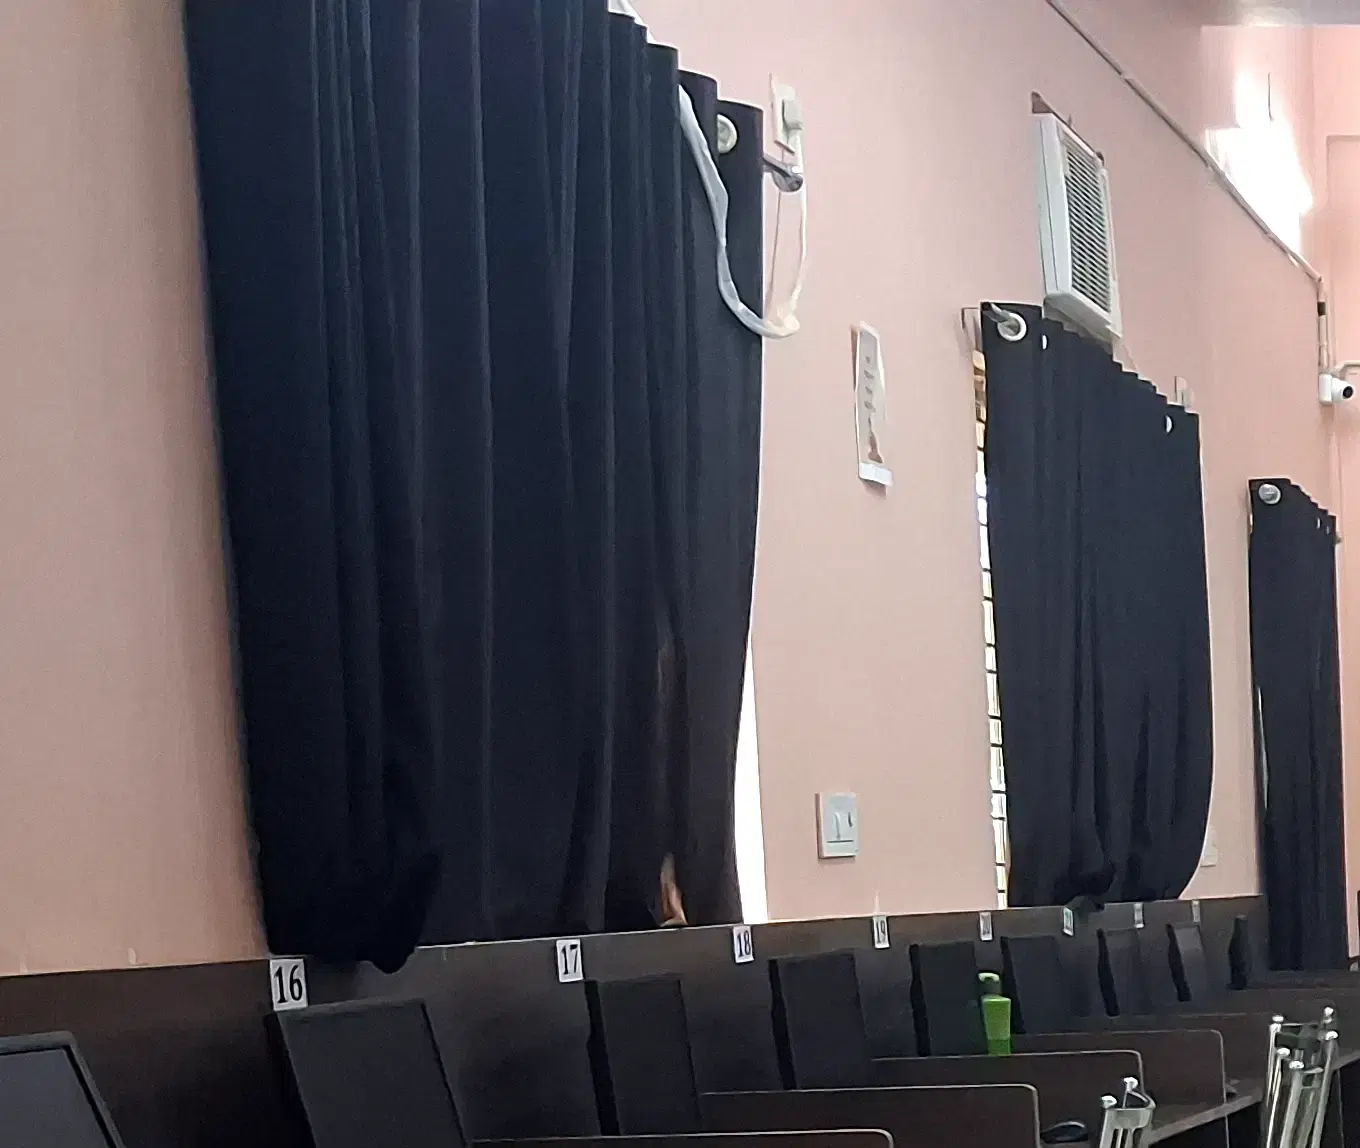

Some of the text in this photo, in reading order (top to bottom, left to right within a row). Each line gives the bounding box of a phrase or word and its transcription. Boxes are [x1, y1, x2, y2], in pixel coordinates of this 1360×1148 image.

[736, 930, 751, 957] 18
[561, 944, 579, 975] 17
[273, 964, 303, 1004] 16
